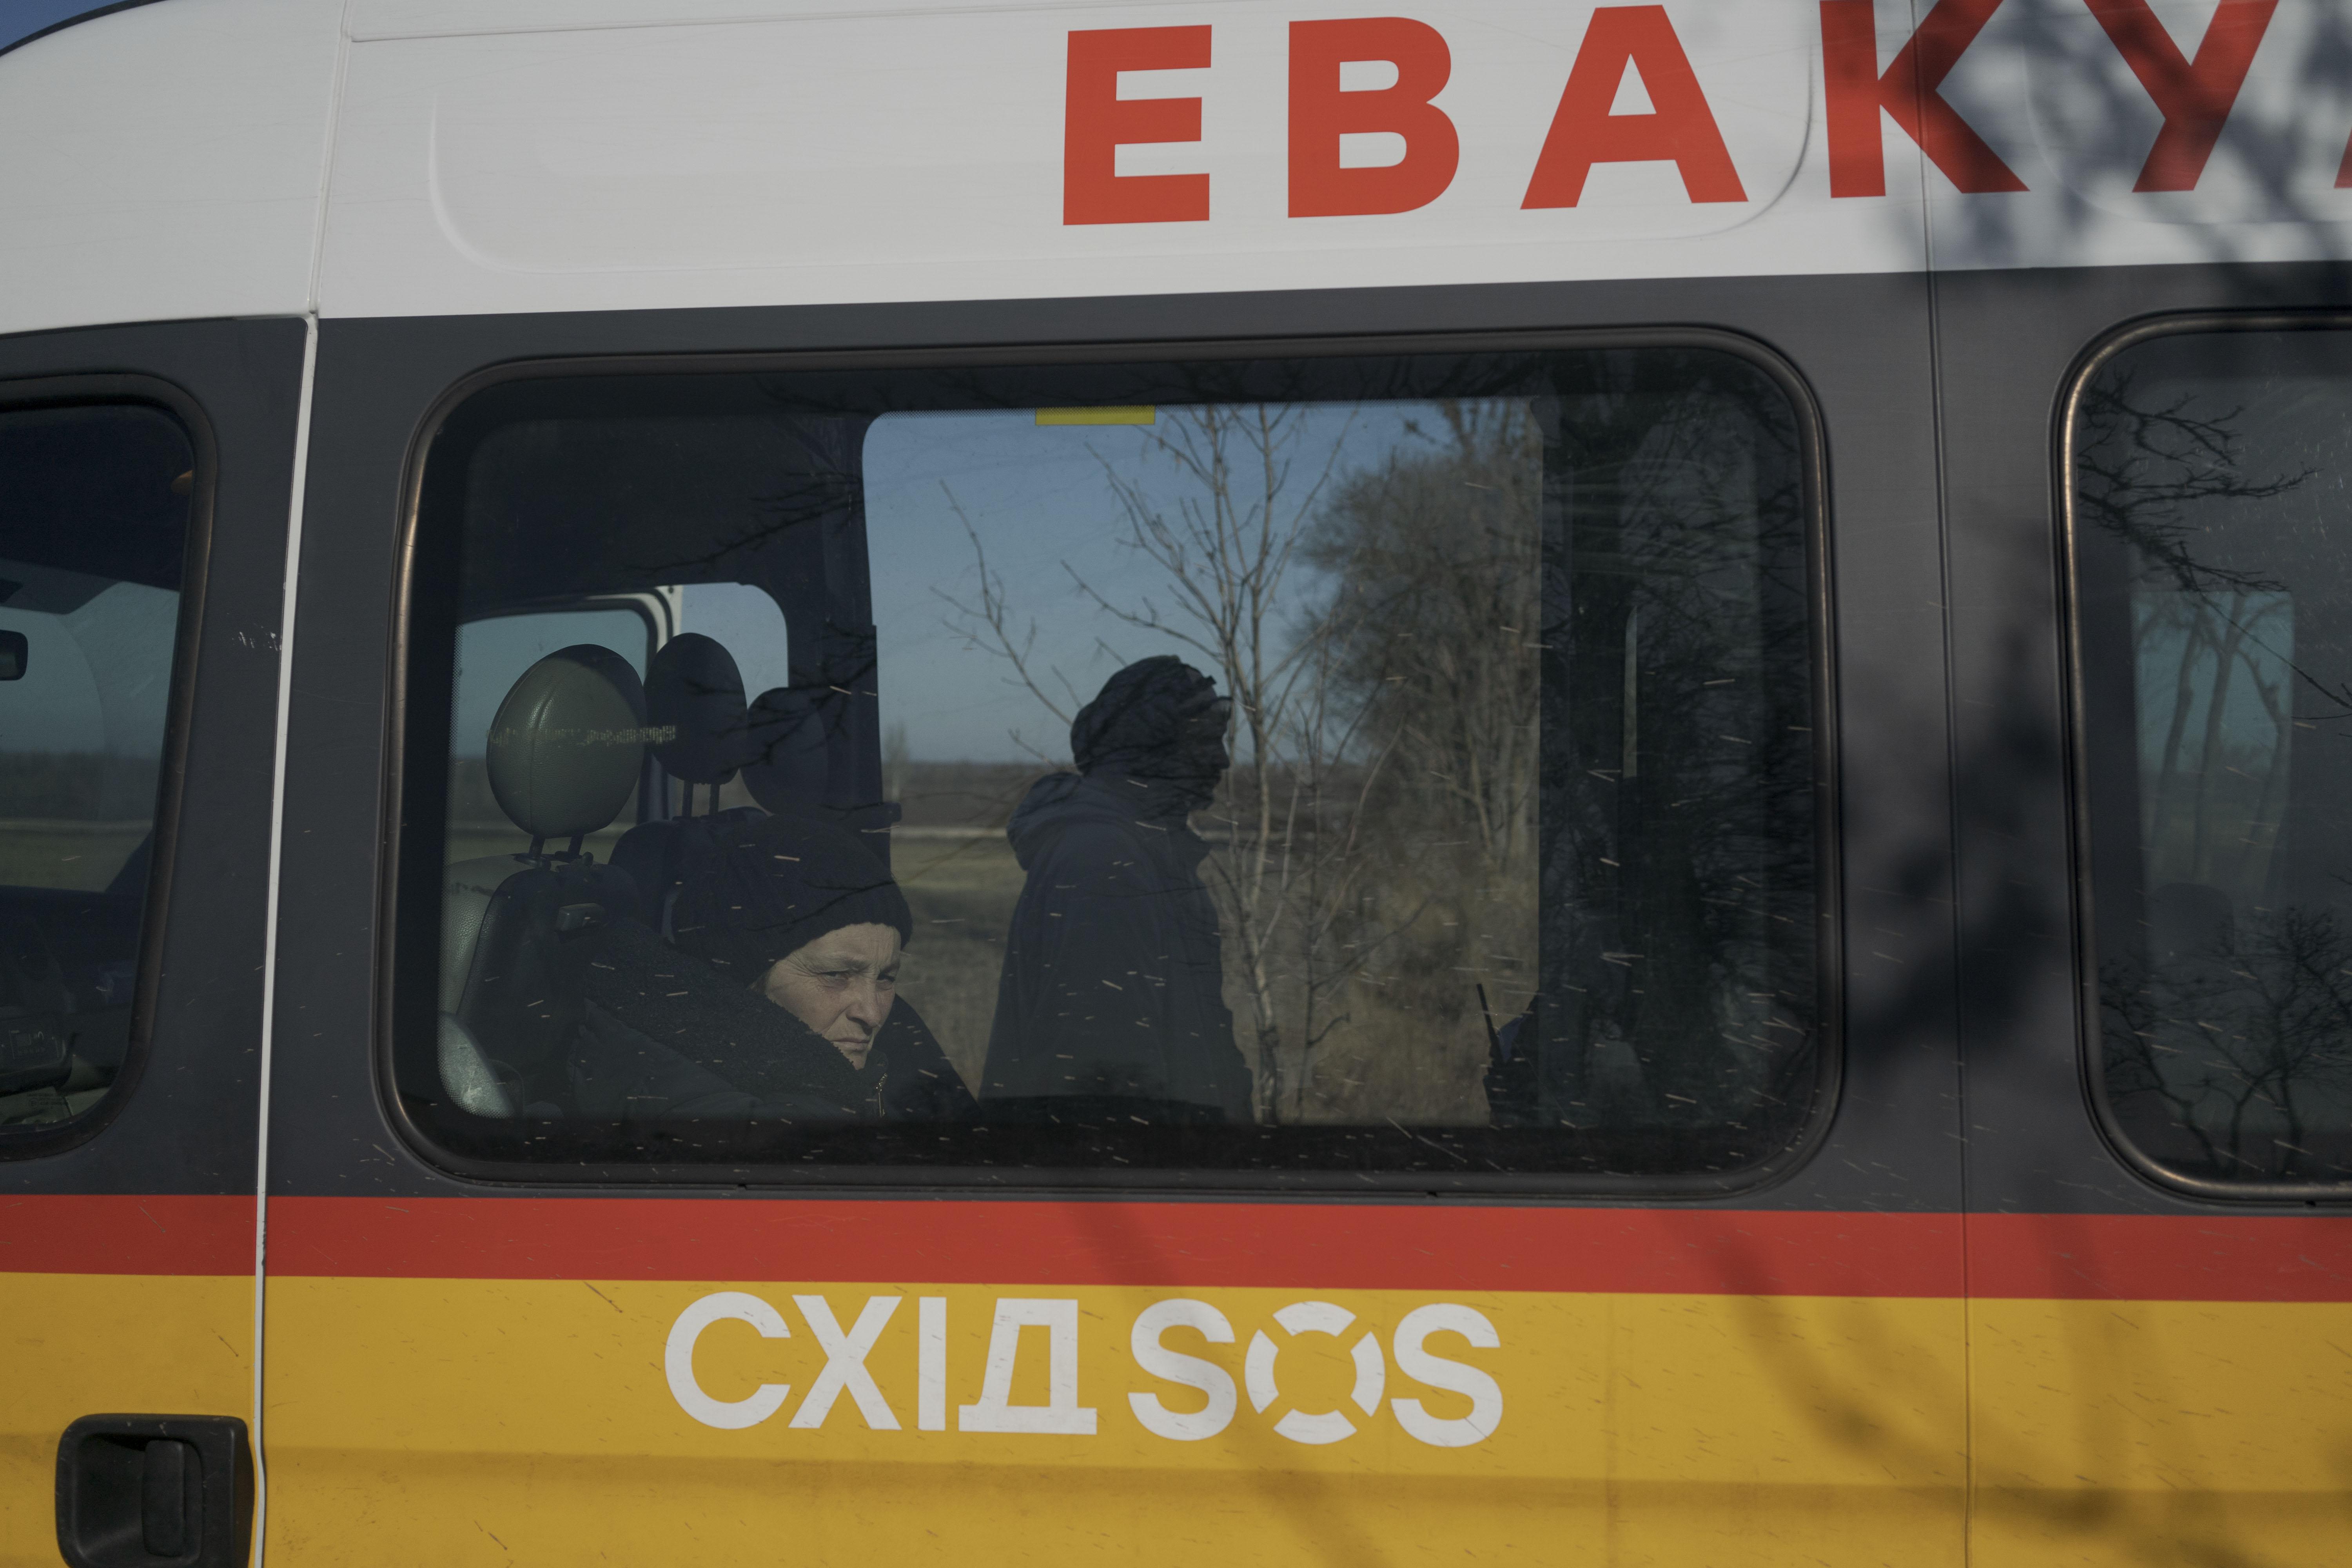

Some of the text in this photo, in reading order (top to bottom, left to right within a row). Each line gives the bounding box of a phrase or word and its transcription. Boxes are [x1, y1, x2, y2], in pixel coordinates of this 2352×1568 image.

[1063, 0, 2352, 226] ЕВАКУ
[664, 1291, 1503, 1447] СХІД SOS
